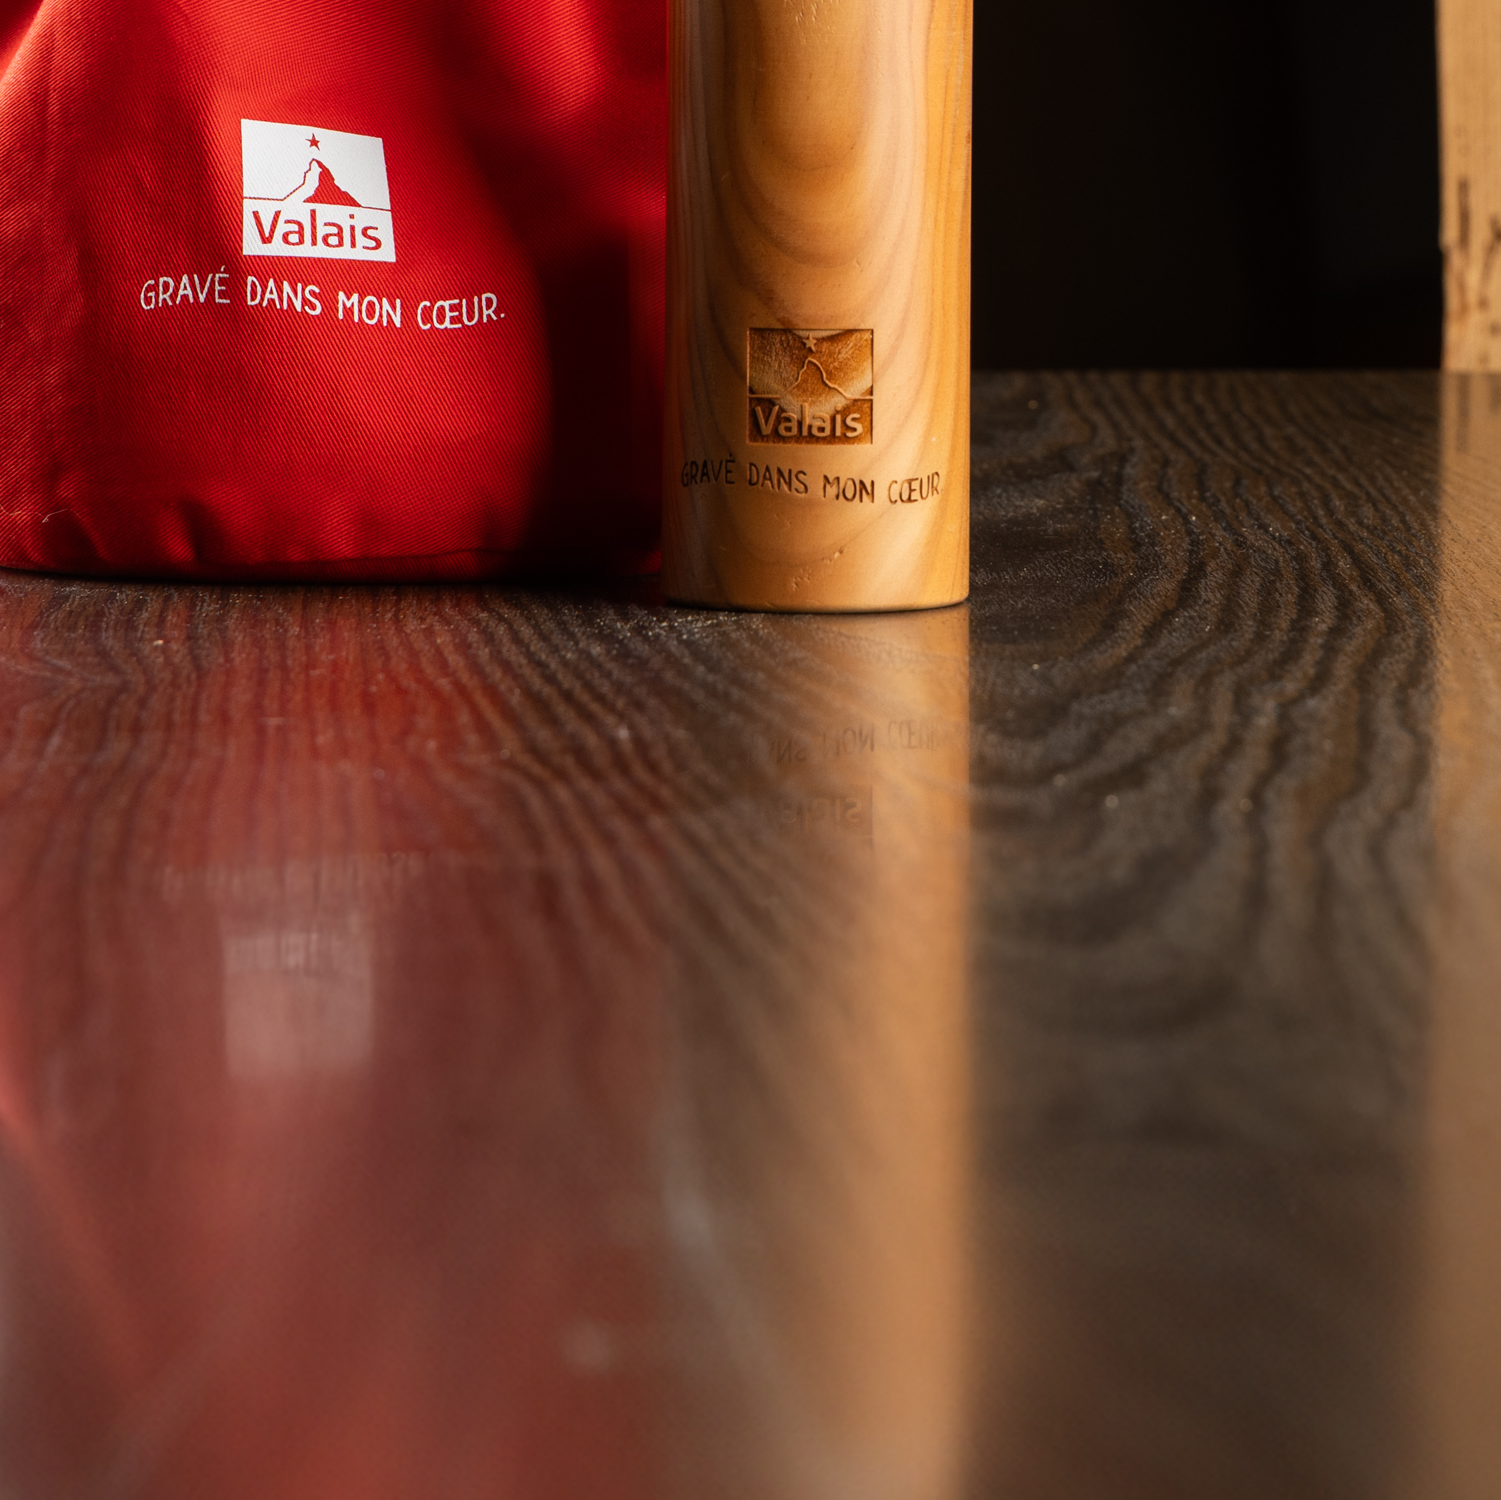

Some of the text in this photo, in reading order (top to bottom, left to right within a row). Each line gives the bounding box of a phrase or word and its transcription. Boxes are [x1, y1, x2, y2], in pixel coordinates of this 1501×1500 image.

[252, 208, 382, 251] Valais
[140, 266, 505, 329] GRAVÉ DANS MON CŒUR.
[755, 403, 863, 438] Valais
[681, 453, 735, 487] GRAVÉ
[749, 462, 809, 495] DANS
[823, 474, 875, 504] MON
